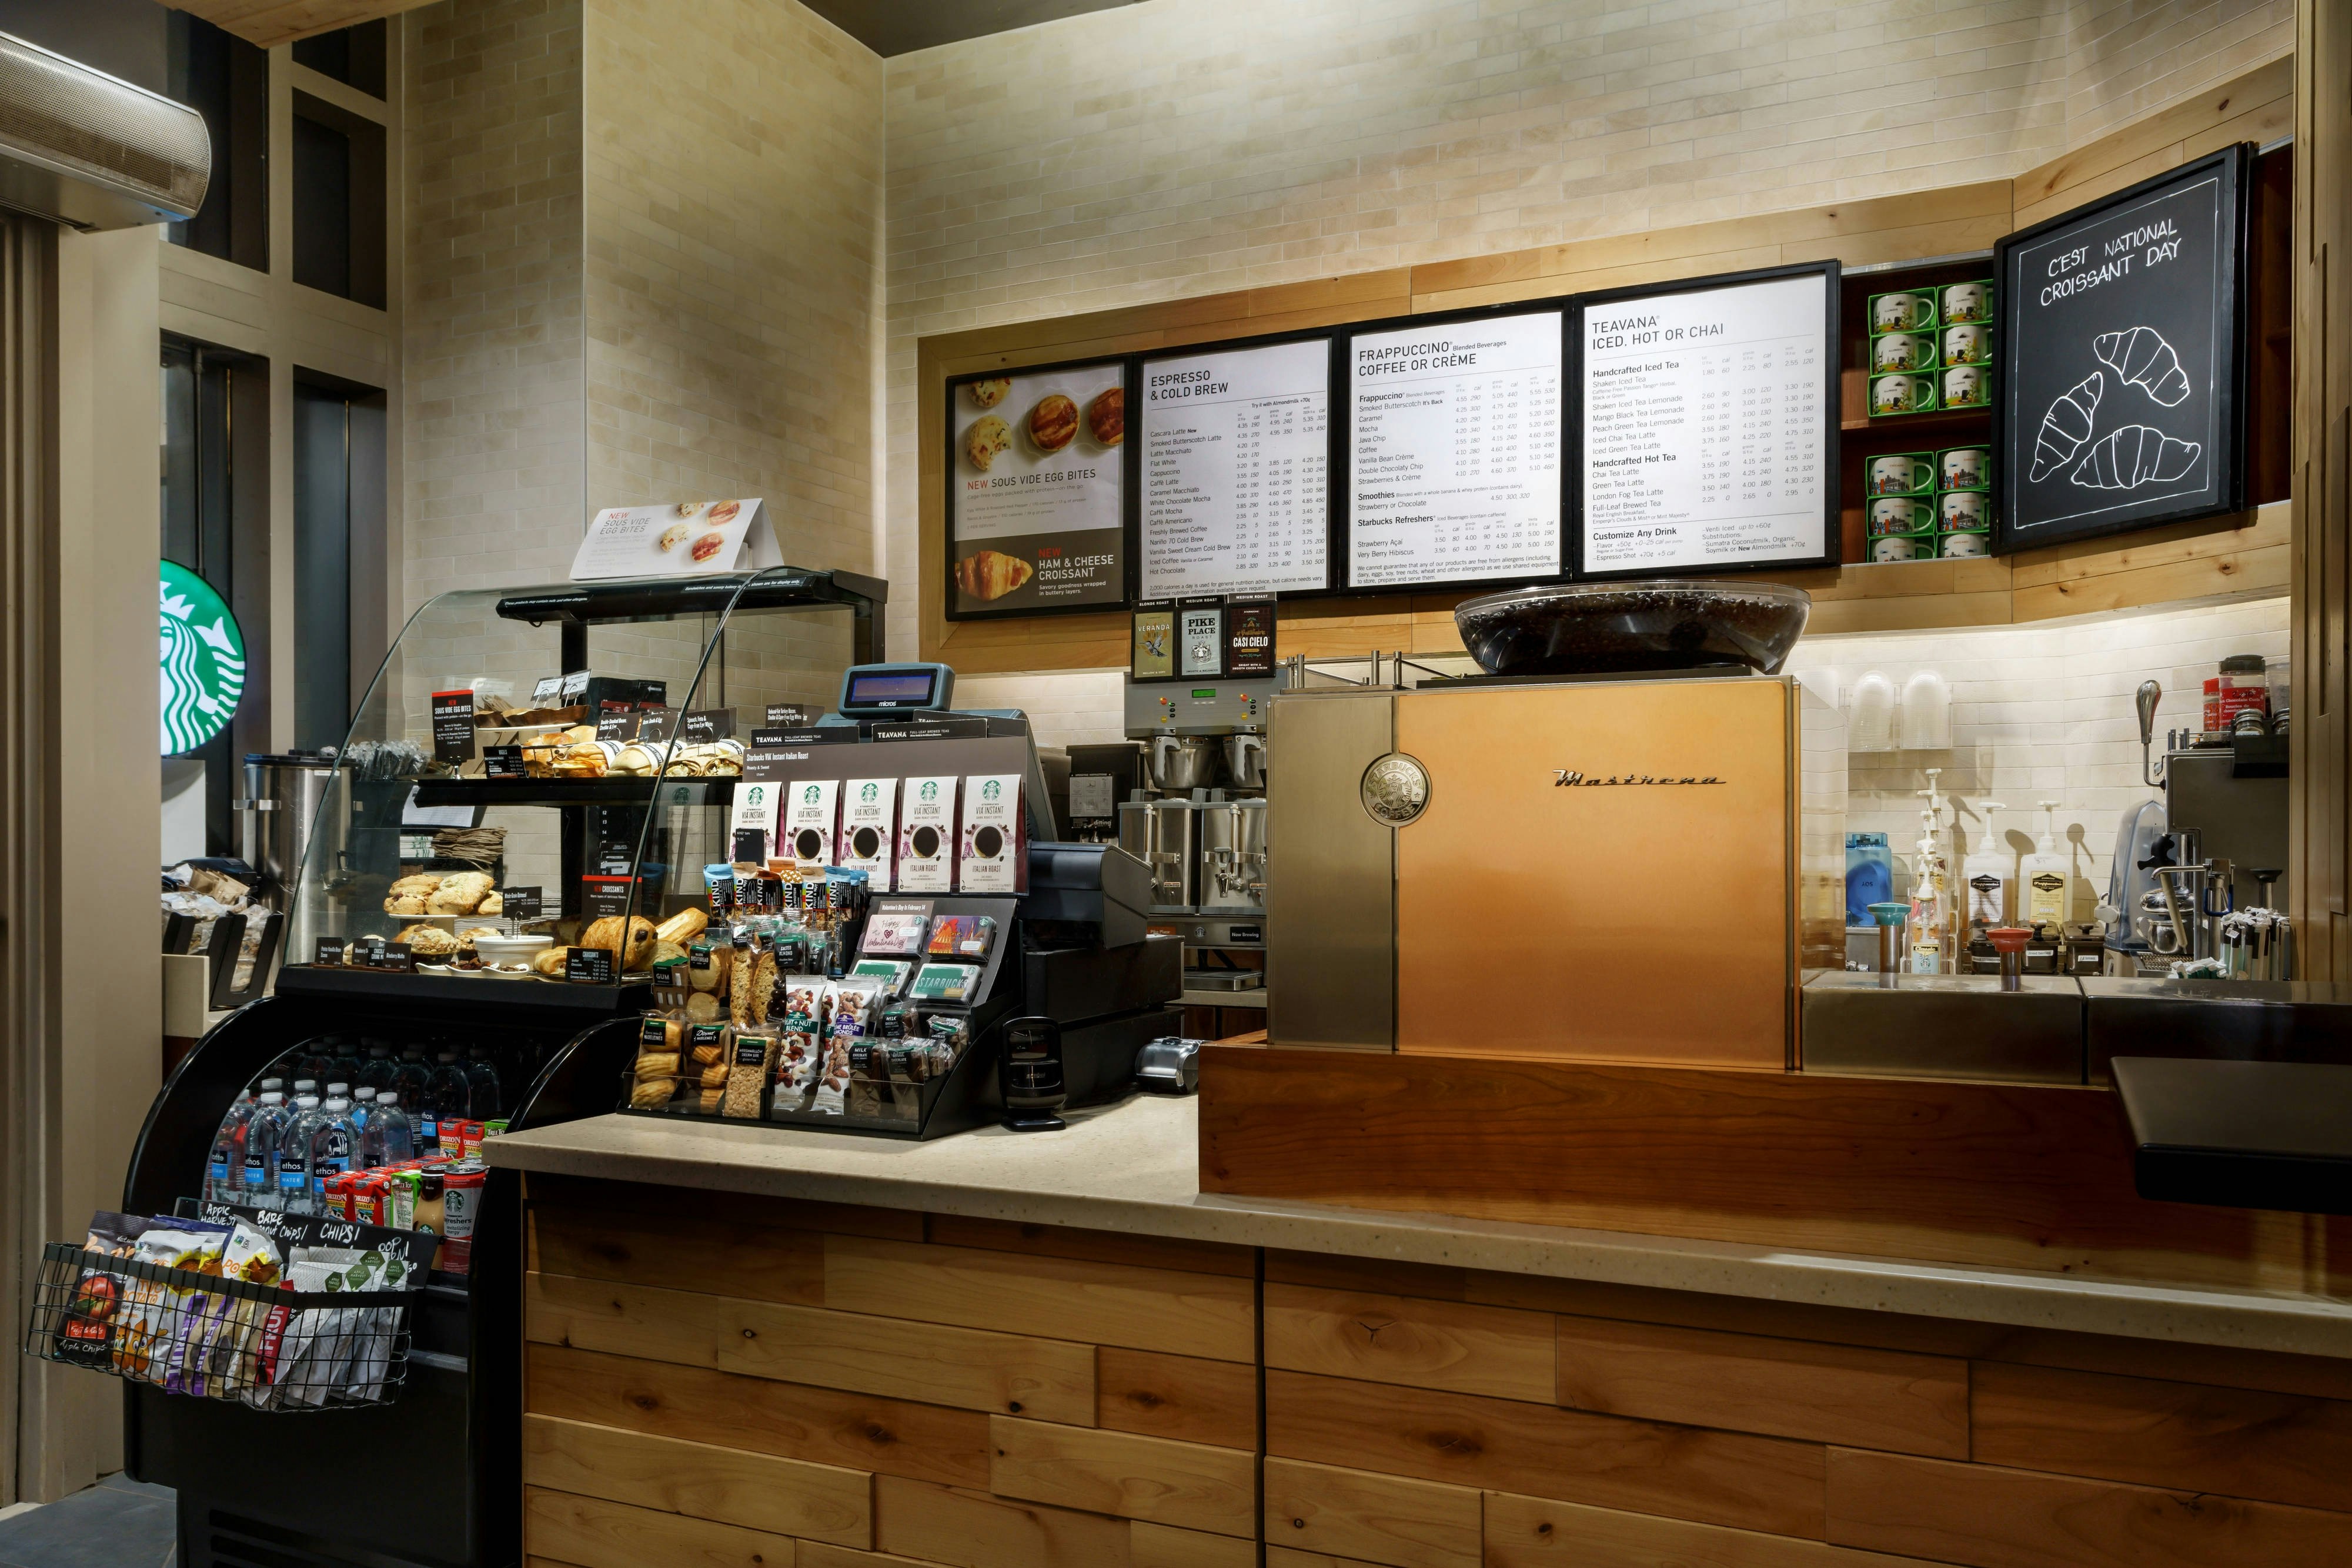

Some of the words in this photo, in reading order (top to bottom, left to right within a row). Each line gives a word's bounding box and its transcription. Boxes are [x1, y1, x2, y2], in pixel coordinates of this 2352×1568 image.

[2105, 218, 2177, 256] NATIONAL
[2040, 255, 2135, 306] CROISSANT
[2146, 238, 2181, 266] DAY
[1592, 316, 1657, 333] TEAVANA
[1592, 336, 1627, 350] ICED,
[1632, 331, 1659, 345] HOT
[1665, 329, 1683, 340] OR
[1689, 323, 1723, 337] CHAI
[1359, 342, 1449, 362] FRAPPUCCINO
[1359, 362, 1406, 376] COFFEE
[1411, 360, 1428, 370] OR
[1432, 353, 1476, 368] CRÈME
[1593, 366, 1642, 377] Handcrafted
[1645, 363, 1662, 371] Iced
[1151, 370, 1210, 387] ESPRESSO
[1151, 391, 1158, 400] &
[1161, 387, 1190, 399] COLD
[1195, 382, 1228, 395] BREW
[1359, 392, 1402, 403] Frappuccino
[1173, 437, 1205, 445] Butterscotch
[1593, 457, 1642, 468] Handcrafted
[1645, 455, 1659, 463] Hot
[968, 480, 988, 490] NEW
[991, 477, 1016, 487] SOUS
[1020, 474, 1041, 484] VIDE
[1045, 472, 1063, 482] EGG
[1068, 469, 1096, 480] BITES
[1358, 492, 1395, 501] Smoothies
[1358, 517, 1392, 527] Starbucks
[1395, 516, 1434, 524] Refreshers
[1593, 531, 1635, 541] Customize
[1637, 530, 1652, 539] Any
[1655, 528, 1677, 536] Drink
[1038, 547, 1061, 557] NEW
[1039, 559, 1060, 569] HAM
[1064, 559, 1071, 567] &
[1075, 555, 1114, 566] CHEESE
[1039, 567, 1094, 580] CROISSANT
[1188, 618, 1215, 627] PIKE
[1233, 637, 1248, 647] CASI
[1250, 637, 1268, 647] CIELO
[1368, 761, 1421, 787] STARBUCKS
[1552, 769, 1726, 787] Mastrena
[1374, 803, 1415, 818] COFFEE
[711, 880, 720, 907] KIND
[736, 878, 744, 905] KIND
[806, 882, 814, 910] KIND
[881, 920, 900, 929] Happy
[918, 977, 969, 988] STARBUCKS
[325, 1192, 347, 1201] ORIZON
[258, 1211, 285, 1225] BARE
